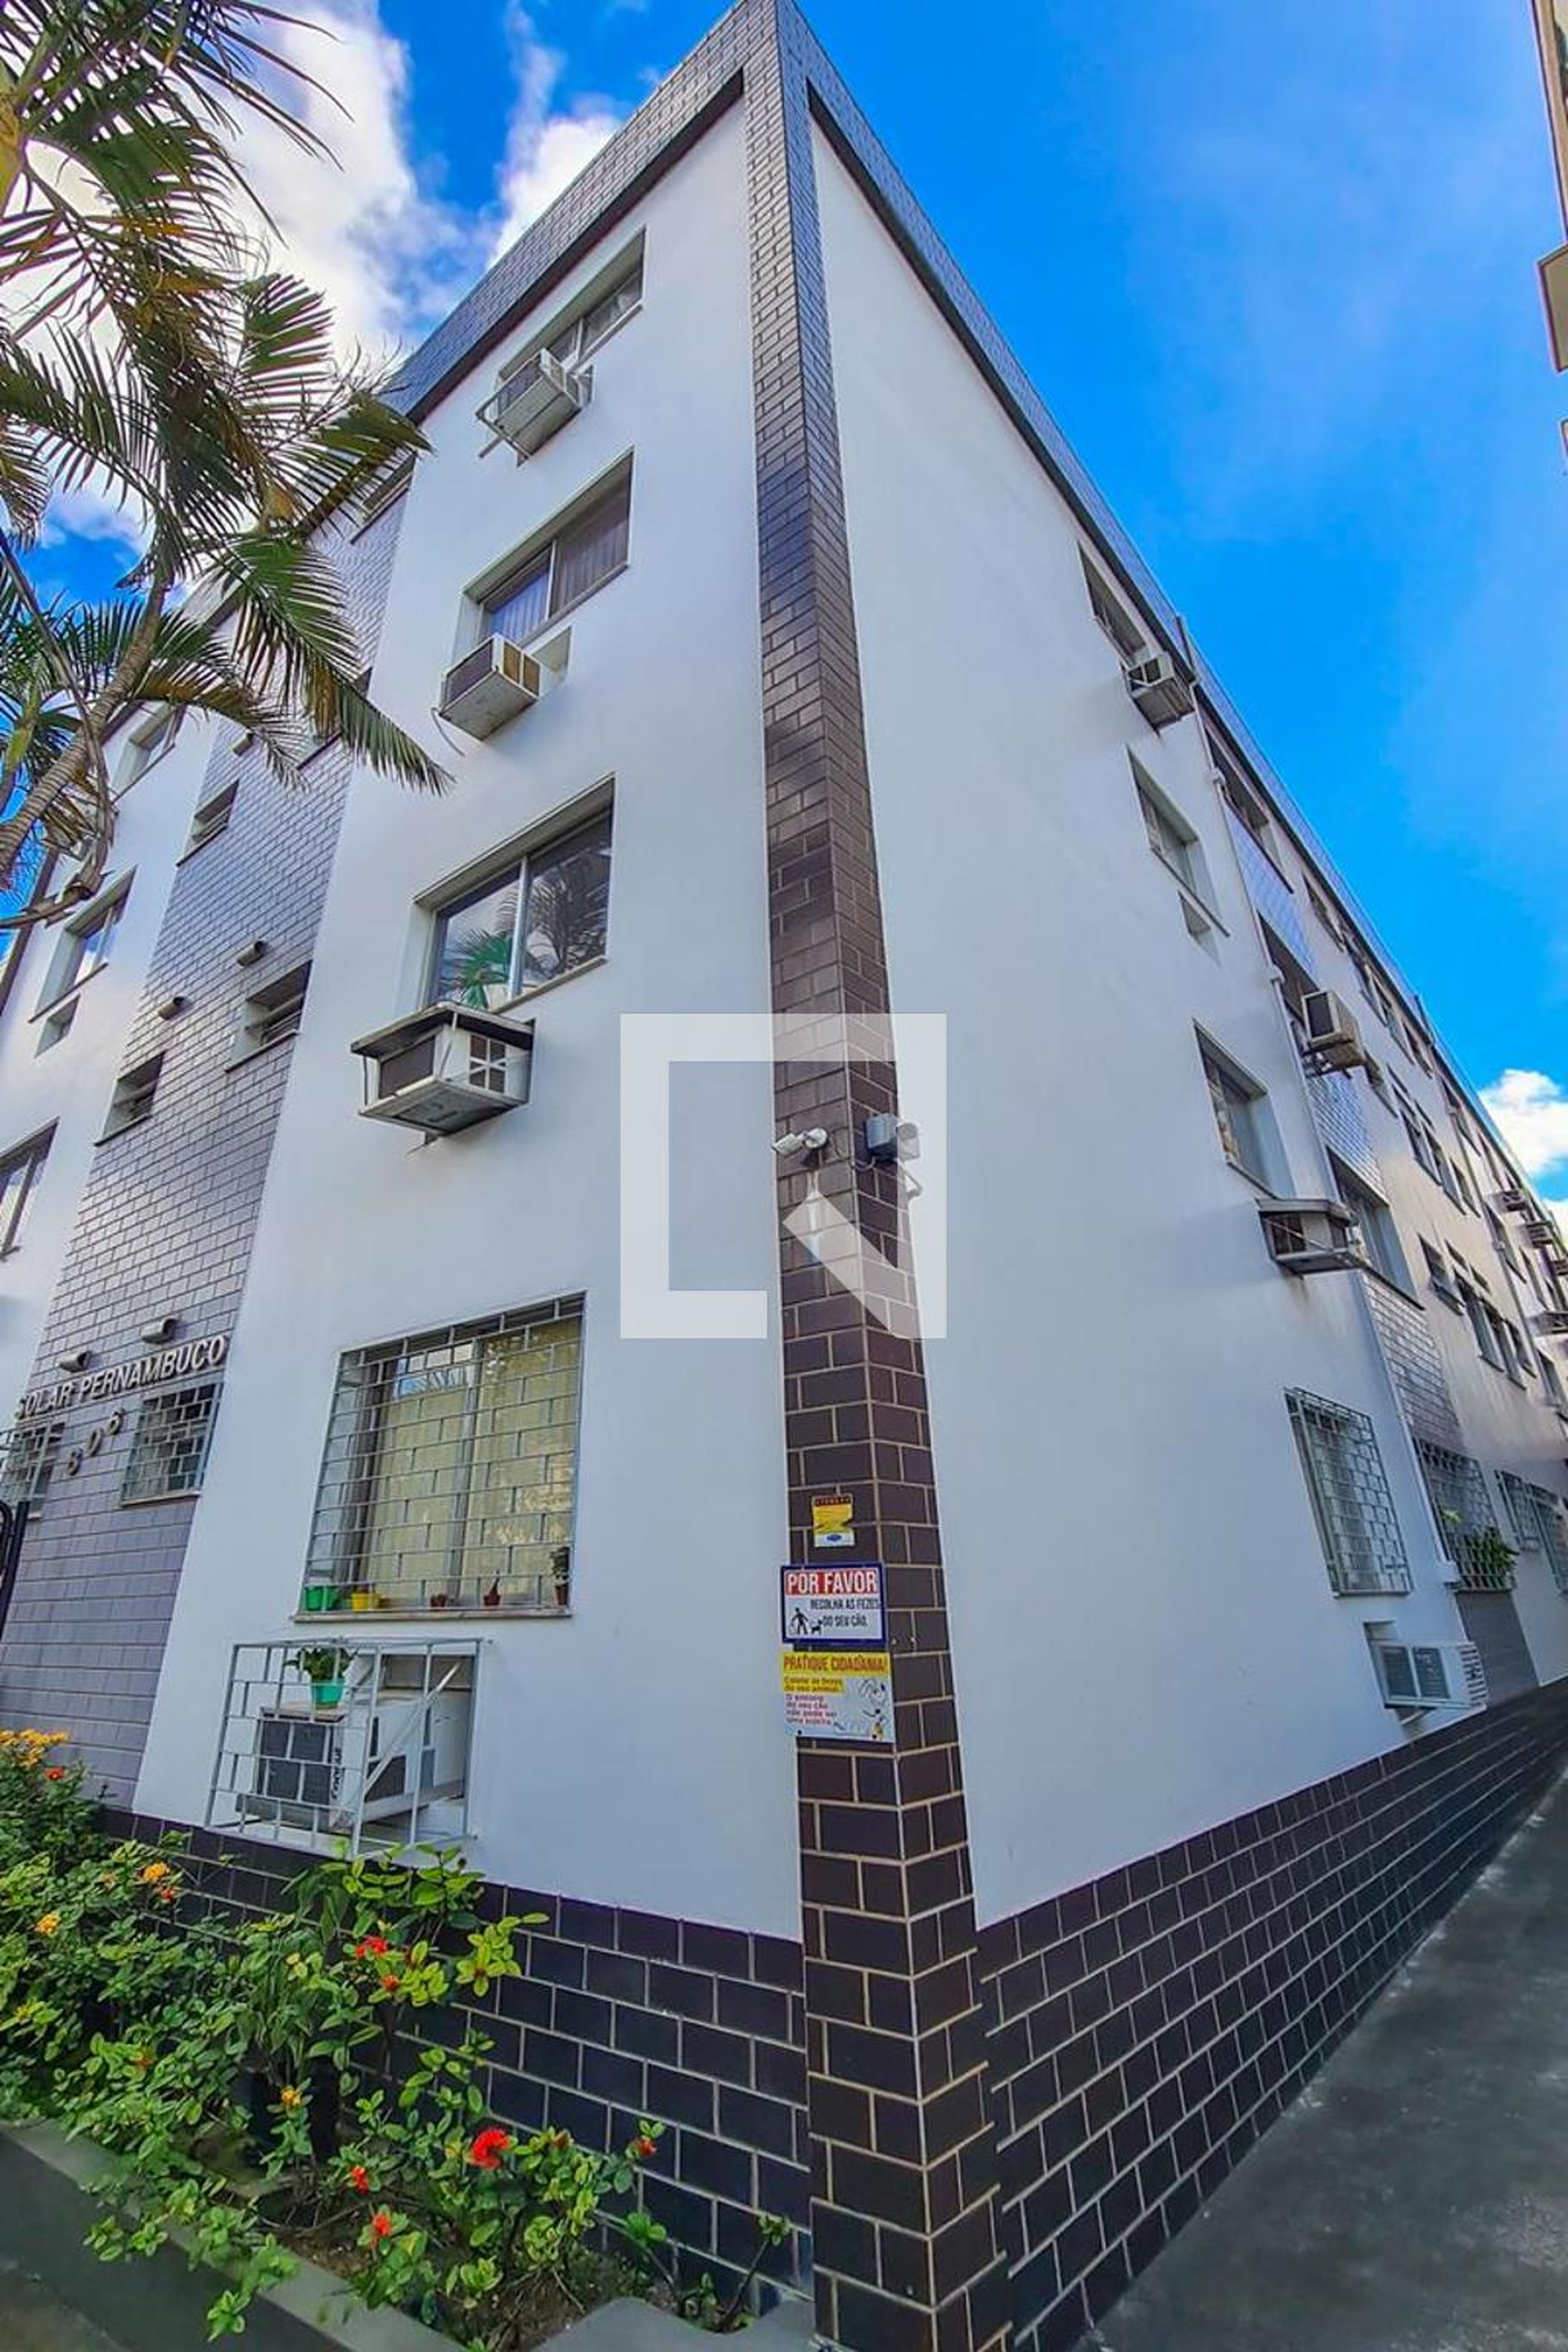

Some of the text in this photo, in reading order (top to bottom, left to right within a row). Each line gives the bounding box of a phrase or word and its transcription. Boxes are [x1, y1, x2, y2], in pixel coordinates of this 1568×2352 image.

[14, 1334, 229, 1419] SOLAR PERNAMBUCO
[788, 1570, 877, 1594] POR FAVOR
[810, 1598, 843, 1610] RECOLHA
[846, 1598, 855, 1610] AS
